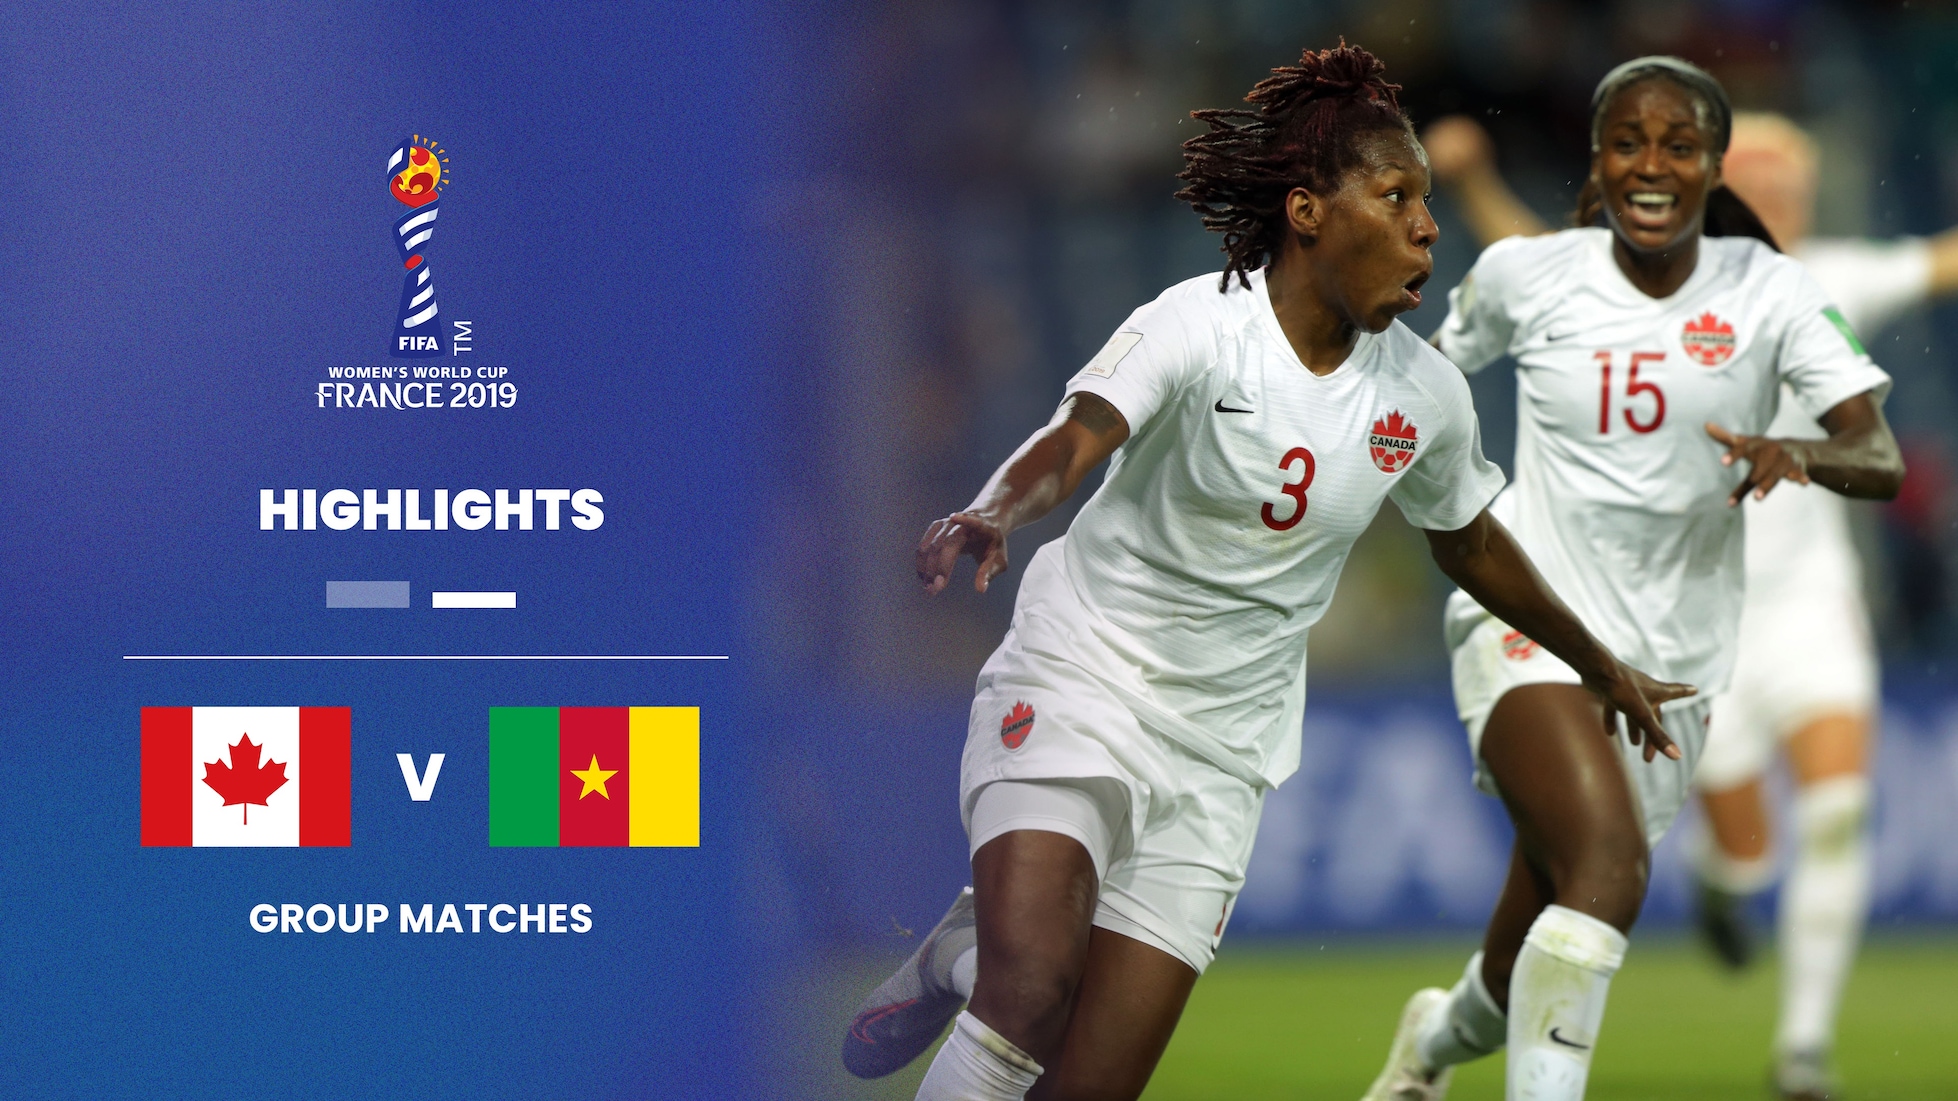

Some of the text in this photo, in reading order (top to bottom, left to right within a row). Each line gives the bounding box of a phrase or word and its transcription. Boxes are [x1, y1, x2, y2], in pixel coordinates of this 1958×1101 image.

[1593, 351, 1667, 435] 15
[1370, 436, 1416, 451] CANADA
[1260, 446, 1316, 531] 3
[1000, 715, 1036, 737] CANADA
